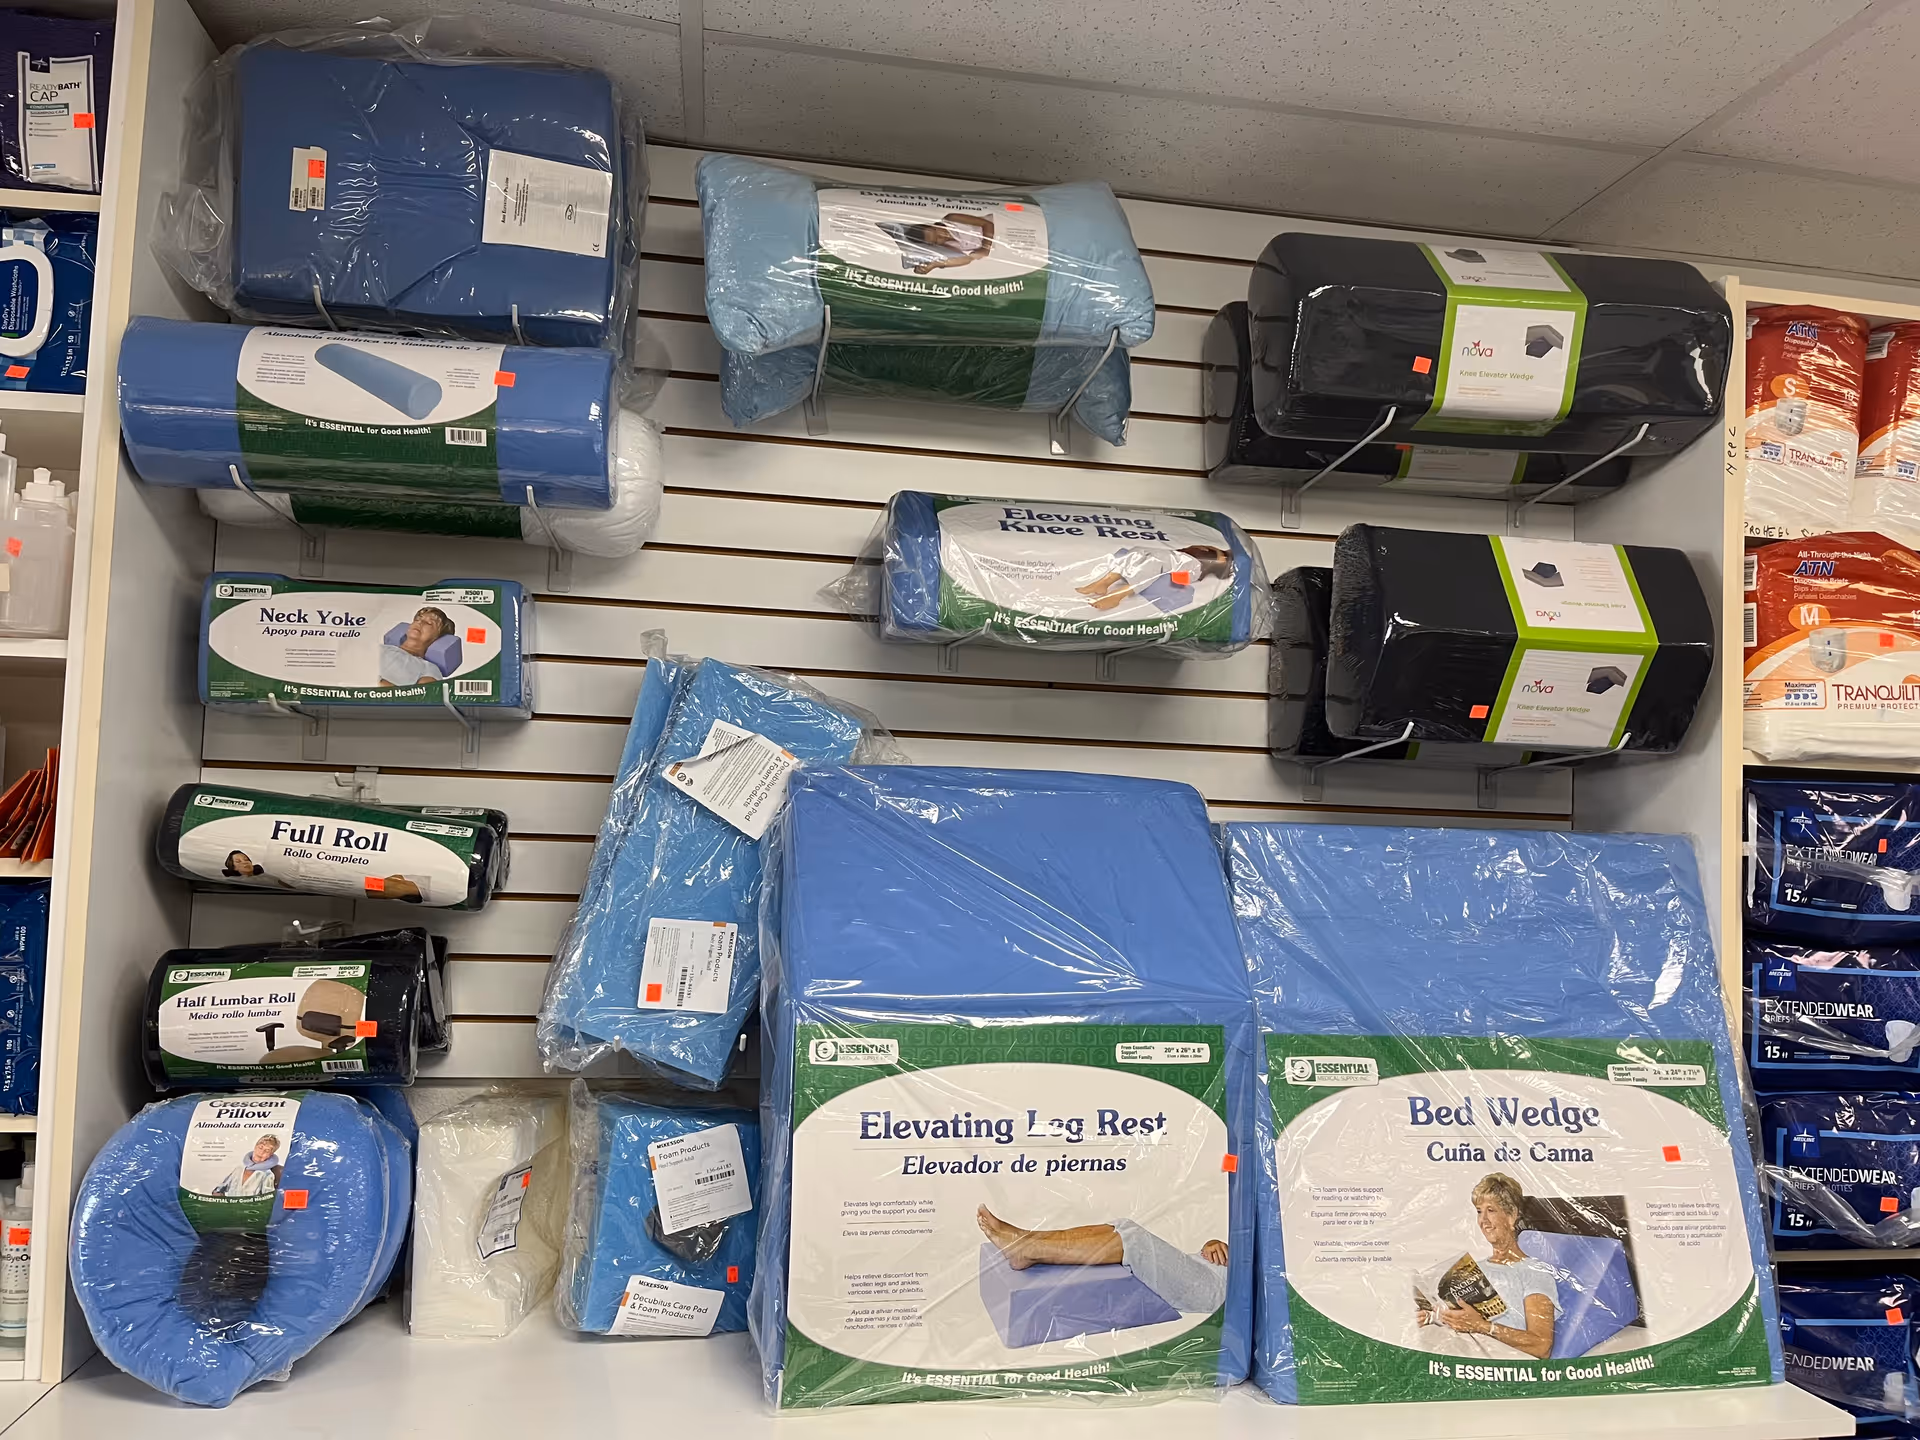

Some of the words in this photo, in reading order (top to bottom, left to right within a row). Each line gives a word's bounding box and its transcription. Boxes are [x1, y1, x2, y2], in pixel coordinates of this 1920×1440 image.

[30, 91, 59, 102] CAP
[11, 265, 19, 297] Washcloths
[865, 274, 929, 294] ESSENTIAL
[932, 284, 949, 295] for
[952, 284, 981, 296] Good
[984, 280, 1024, 296] Health!
[8, 296, 16, 331] Disposable
[67, 335, 74, 343] 50
[1786, 323, 1818, 341] ATN
[1461, 344, 1494, 358] nova
[1459, 370, 1478, 378] Knee
[1479, 370, 1508, 379] Elevator
[1509, 372, 1534, 381] Wedge
[1783, 377, 1797, 396] S
[305, 417, 318, 428] It's
[319, 420, 365, 434] ESSENTIAL
[366, 426, 379, 435] for
[380, 426, 401, 436] Good
[403, 426, 432, 436] Health!
[1002, 507, 1155, 529] Elevating
[998, 519, 1084, 537] Knee
[1094, 525, 1170, 541] Rest
[1794, 561, 1835, 576] ATN
[259, 606, 309, 624] Neck
[316, 608, 367, 626] Yoke
[993, 611, 1011, 625] It's
[1014, 615, 1080, 635] ESSENTIAL
[1082, 624, 1100, 636] for
[1103, 624, 1134, 636] Good
[1137, 619, 1179, 635] Health!
[1800, 606, 1819, 625] M
[261, 626, 298, 638] Apoyo
[300, 628, 326, 638] para
[329, 628, 361, 638] cuello
[284, 684, 298, 695] It's
[300, 687, 352, 699] ESSENTIAL
[353, 689, 368, 699] for
[369, 688, 396, 699] Good
[398, 686, 427, 698] Health!
[1522, 683, 1554, 694] nova
[1516, 703, 1534, 711] Knee
[1535, 704, 1564, 712] Elevator
[764, 761, 790, 793] Decubitus
[752, 793, 768, 810] Care
[744, 809, 757, 822] Pad
[270, 820, 326, 845] Full
[333, 827, 389, 853] Roll
[283, 847, 313, 860] Rollo
[316, 851, 371, 866] Completo
[1784, 888, 1801, 903] 15
[717, 931, 726, 950] Foam
[712, 952, 723, 983] Products
[176, 996, 207, 1008] Half
[211, 995, 264, 1007] Lumbar
[268, 992, 296, 1004] Roll
[1765, 999, 1874, 1018] EXTENDEDWEAR
[188, 1011, 219, 1021] Medio
[221, 1010, 245, 1019] rollo
[247, 1008, 281, 1018] lumbar
[839, 1044, 891, 1054] ESSENTIAL
[1764, 1046, 1780, 1059] 15
[293, 1061, 316, 1069] Health!
[1315, 1063, 1369, 1074] ESSENTIAL
[208, 1100, 287, 1108] Crescent
[216, 1108, 272, 1119] Pillow
[1408, 1096, 1474, 1127] Bed
[1486, 1096, 1601, 1133] Wedge
[194, 1121, 241, 1129] Almohada
[859, 1111, 1014, 1143] Elevating
[1027, 1108, 1085, 1143] Leg
[1097, 1108, 1168, 1138] Rest
[658, 1149, 679, 1161] Foam
[680, 1141, 711, 1155] Products
[1426, 1140, 1486, 1163] Cuña
[1494, 1141, 1521, 1163] de
[1529, 1142, 1595, 1163] Cama
[902, 1153, 1003, 1176] Elevador
[1011, 1153, 1038, 1174] de
[1044, 1154, 1128, 1178] piernas
[1788, 1165, 1898, 1185] EXTENDEDWEAR
[840, 1209, 858, 1217] giving
[859, 1209, 871, 1217] you
[882, 1208, 905, 1217] support
[906, 1209, 917, 1217] you
[918, 1207, 936, 1215] desire
[869, 1200, 882, 1208] legs
[883, 1200, 917, 1208] comfortably
[1787, 1213, 1804, 1227] 15
[844, 1273, 862, 1281] Helps
[882, 1271, 914, 1279] discomfort
[874, 1280, 887, 1288] legs
[629, 1302, 636, 1310] &
[637, 1303, 660, 1315] Foam
[660, 1308, 695, 1320] Products
[632, 1293, 672, 1308] Decubitus
[673, 1301, 692, 1311] Care
[693, 1304, 708, 1314] Pad
[1428, 1359, 1451, 1378] It's
[1454, 1364, 1537, 1382] ESSENTIAL
[1541, 1365, 1562, 1381] for
[1565, 1362, 1603, 1380] Good
[1606, 1353, 1655, 1377] Health!
[1784, 1352, 1875, 1371] ENDEDWEAR
[901, 1371, 922, 1385] It's
[925, 1373, 999, 1386] ESSENTIAL
[1003, 1372, 1022, 1384] for
[1026, 1369, 1061, 1383] Good
[1064, 1362, 1112, 1380] Health!
